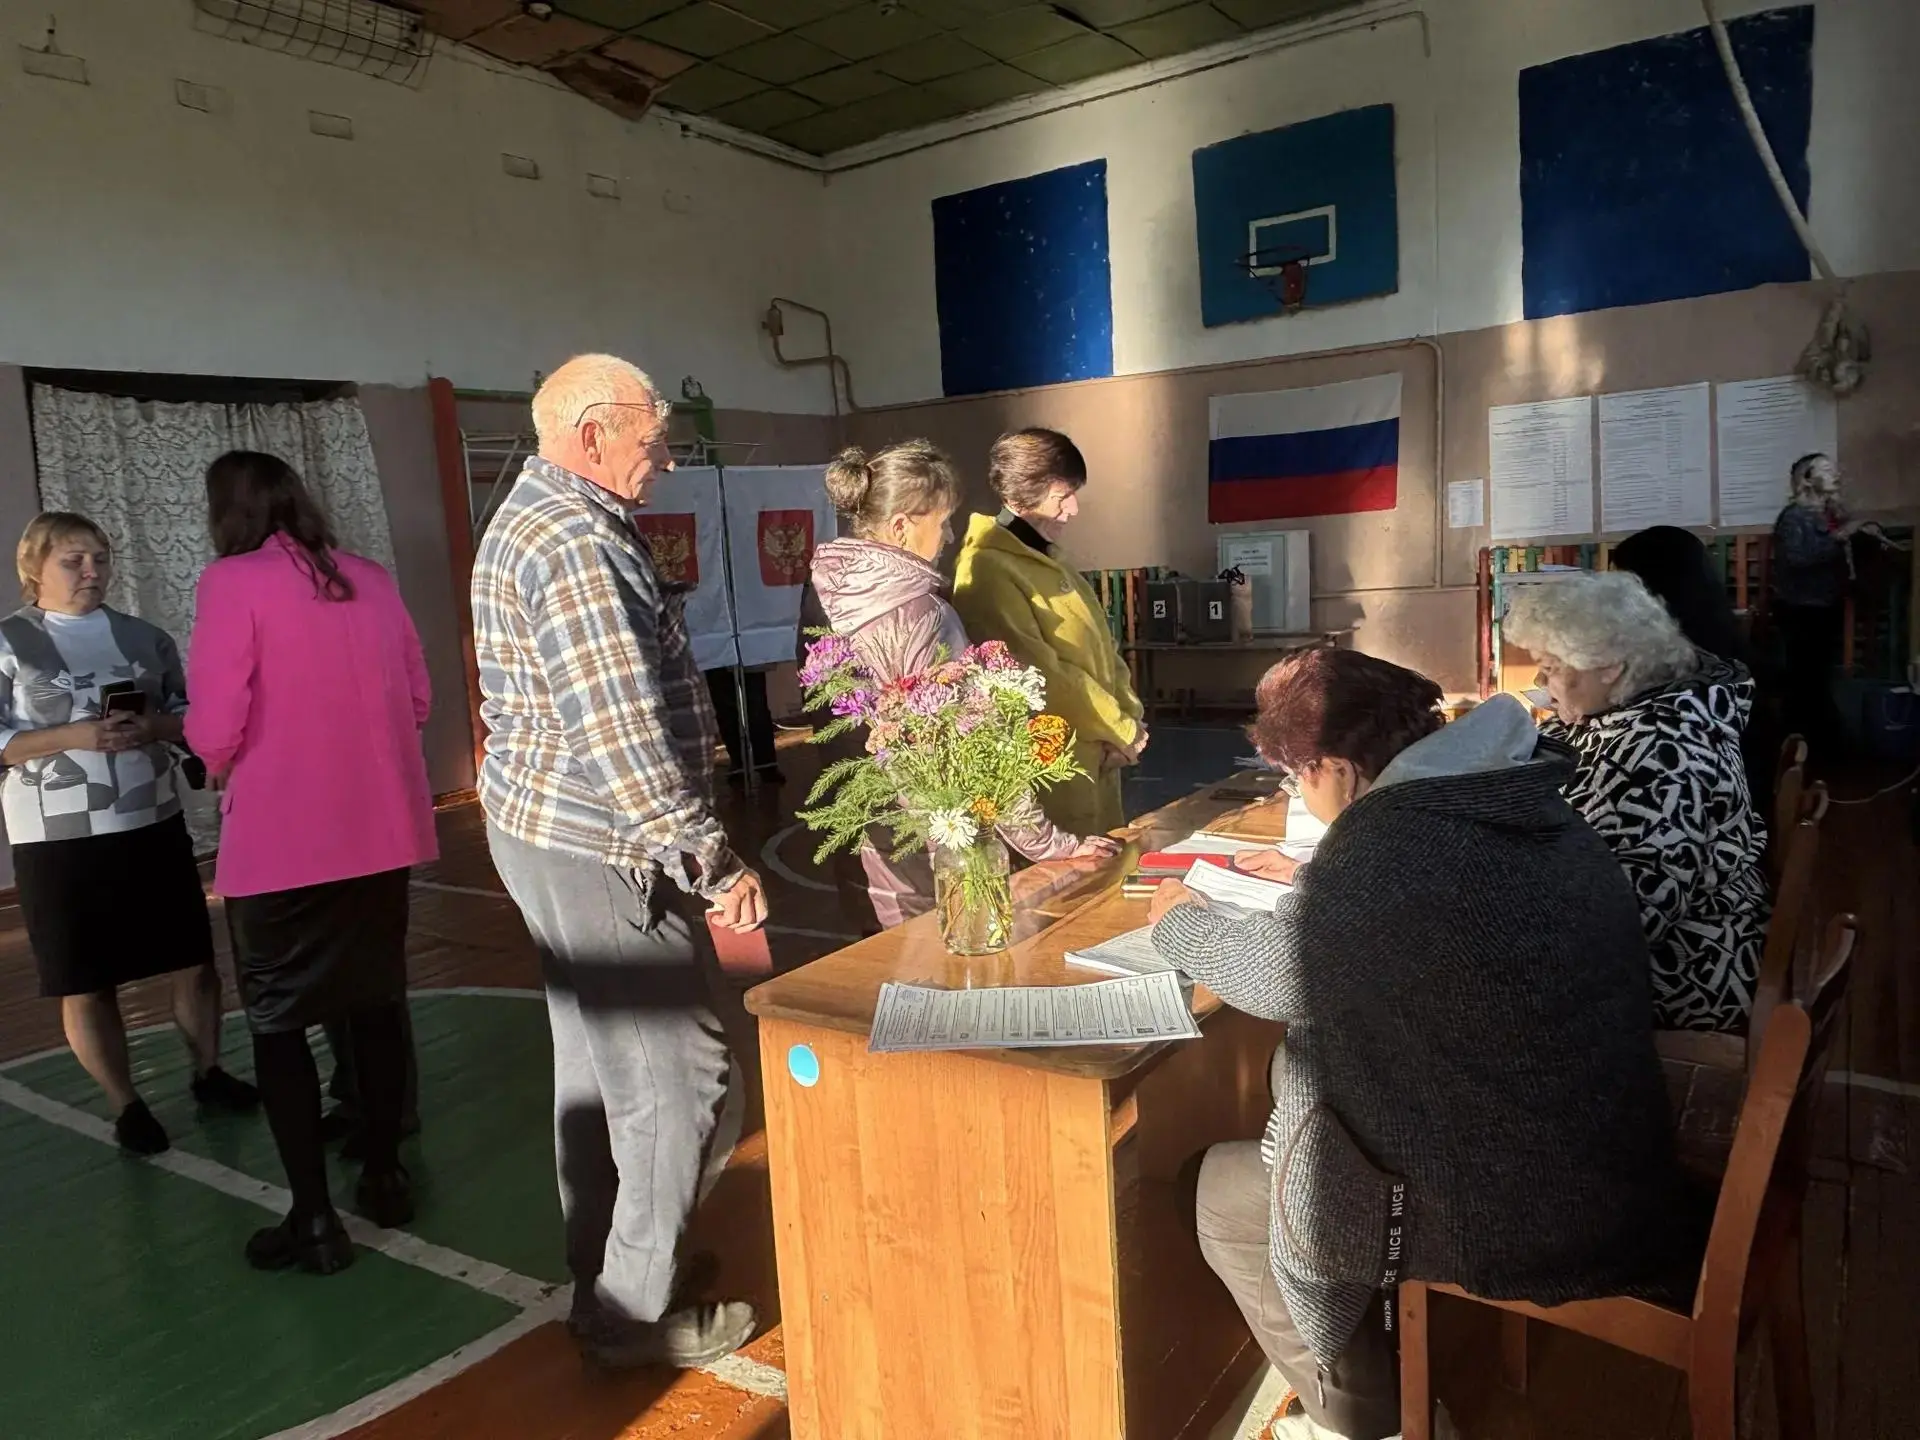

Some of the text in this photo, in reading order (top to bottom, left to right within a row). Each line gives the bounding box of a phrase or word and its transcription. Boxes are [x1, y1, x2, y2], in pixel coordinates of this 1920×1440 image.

[1155, 603, 1164, 615] 2
[1211, 604, 1219, 616] 1
[1391, 1183, 1405, 1217] NICE
[1388, 1226, 1402, 1260] NICE
